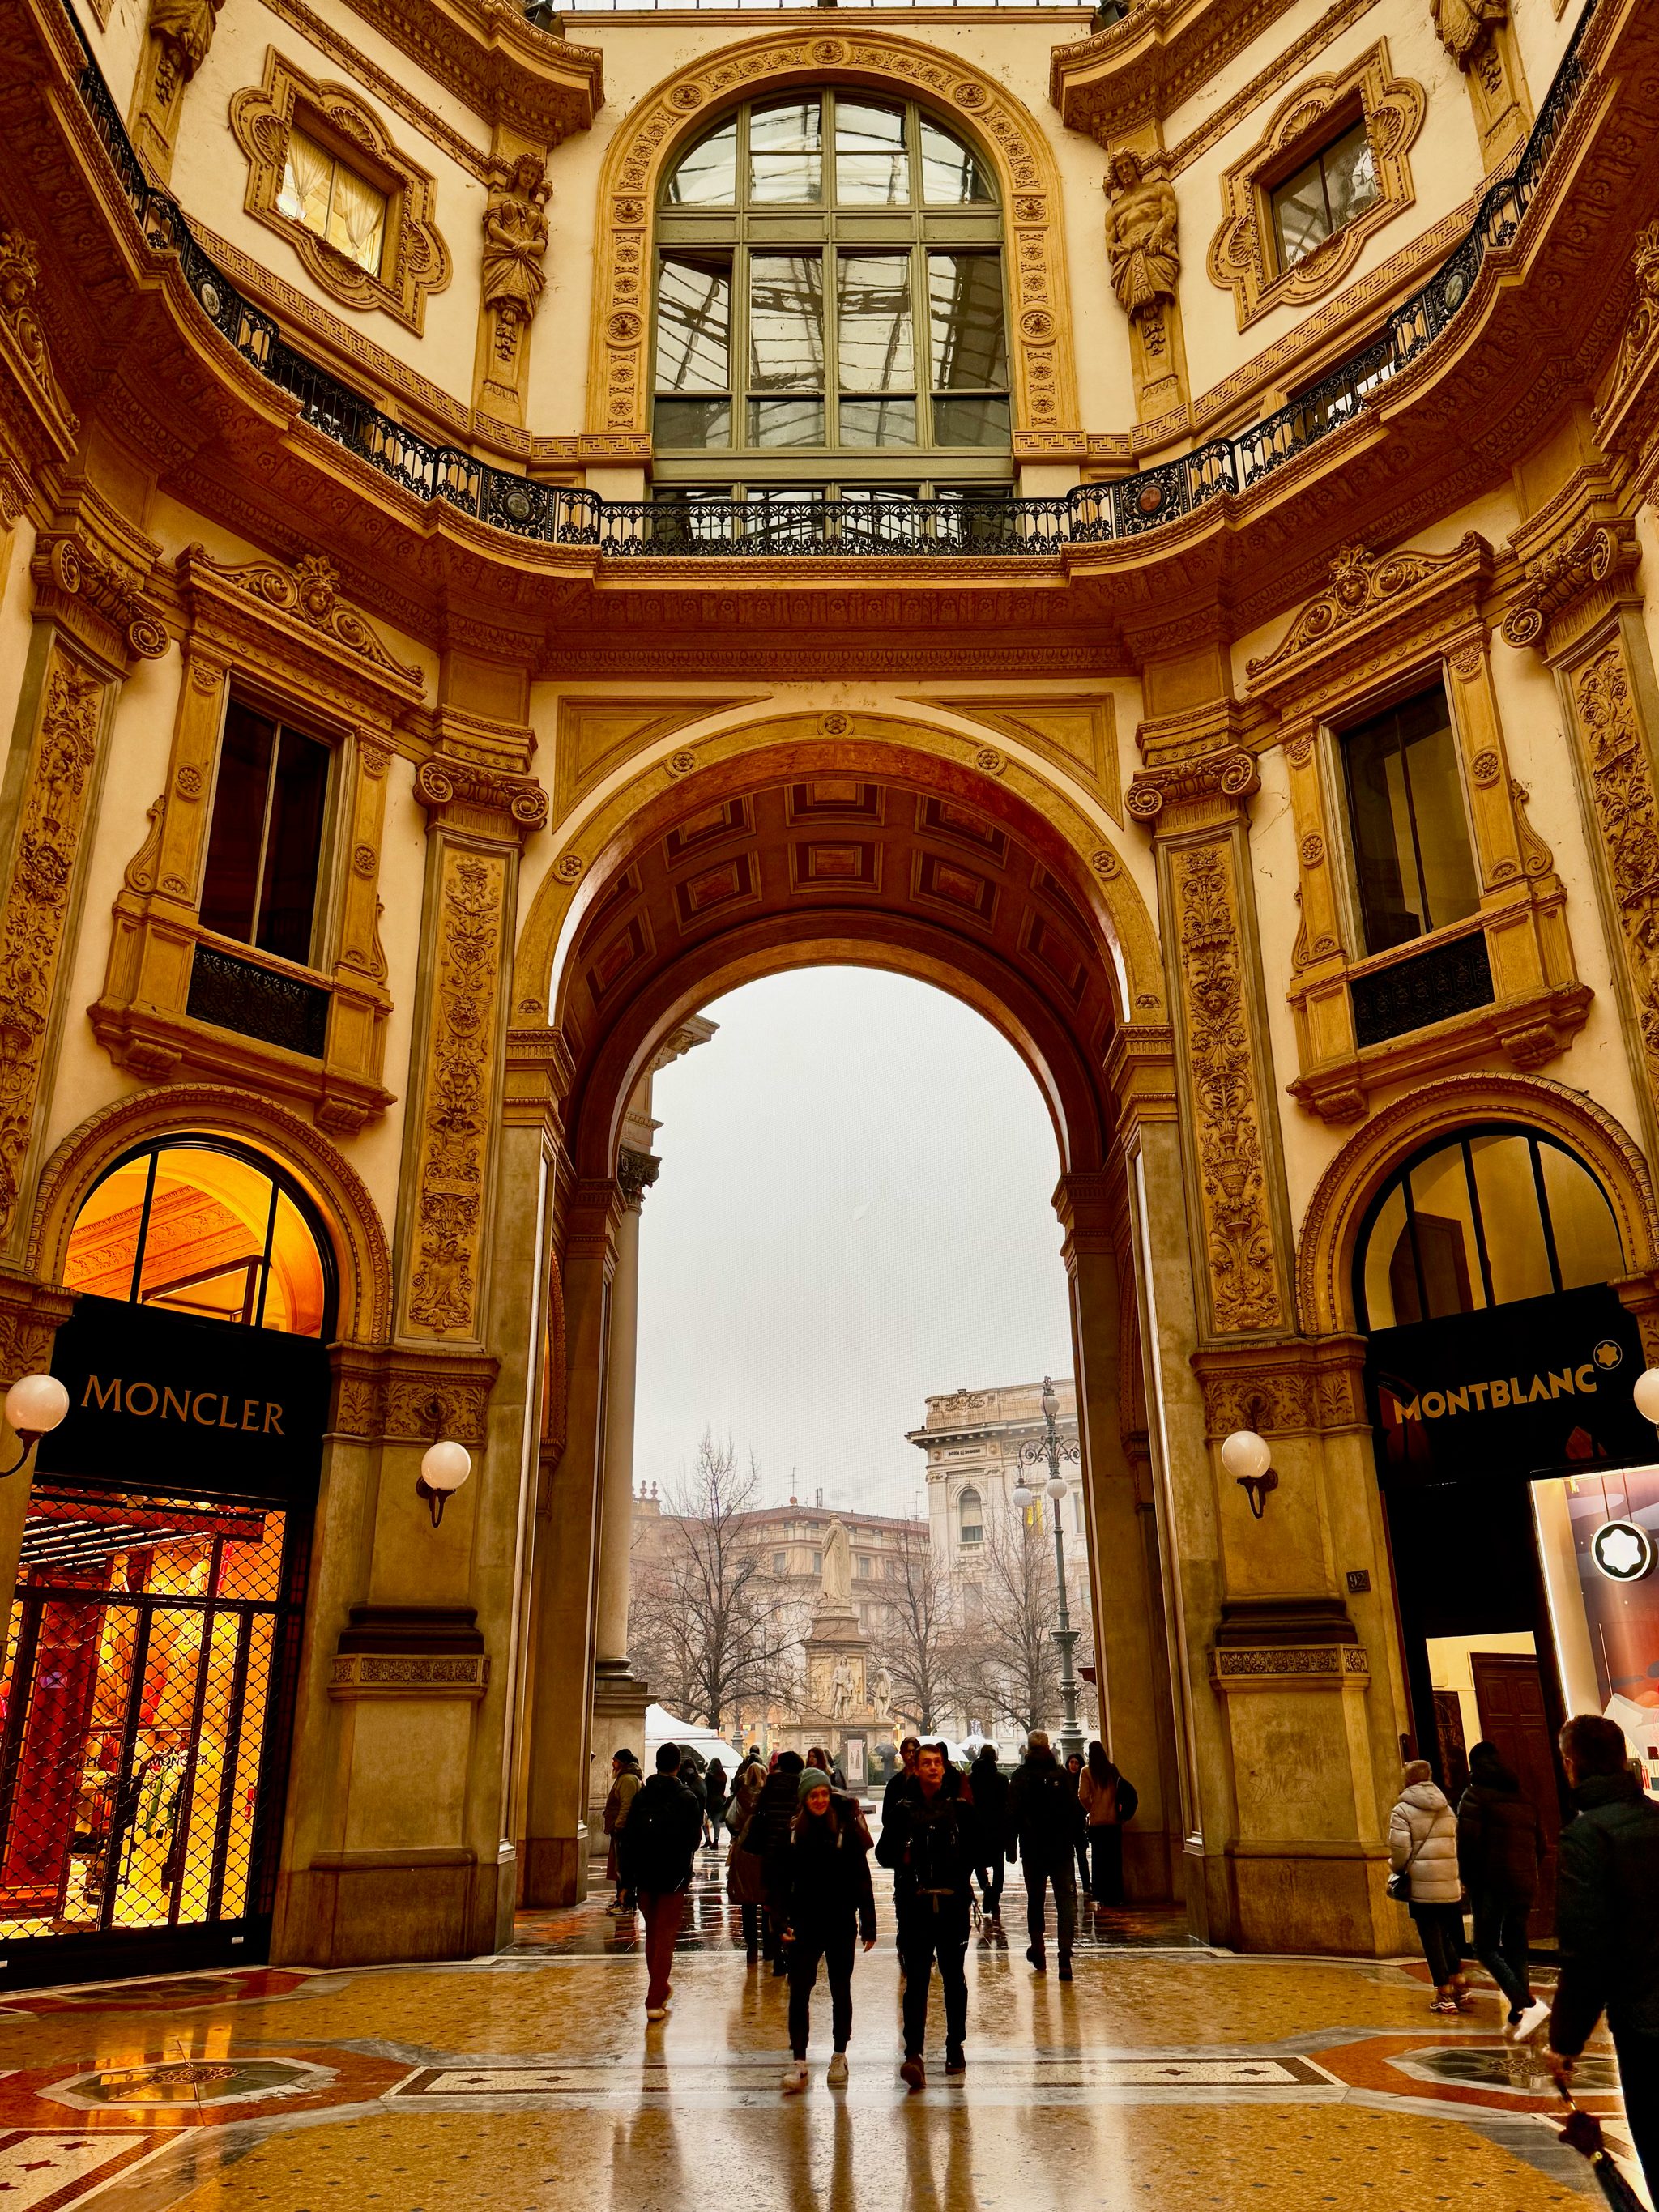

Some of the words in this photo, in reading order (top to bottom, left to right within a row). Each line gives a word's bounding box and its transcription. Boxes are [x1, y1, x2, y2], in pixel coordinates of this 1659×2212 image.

[80, 1375, 285, 1435] MONCLER
[1392, 1363, 1597, 1424] MONTBLANC
[1350, 1572, 1366, 1588] 92
[149, 1755, 208, 1766] MONCER
